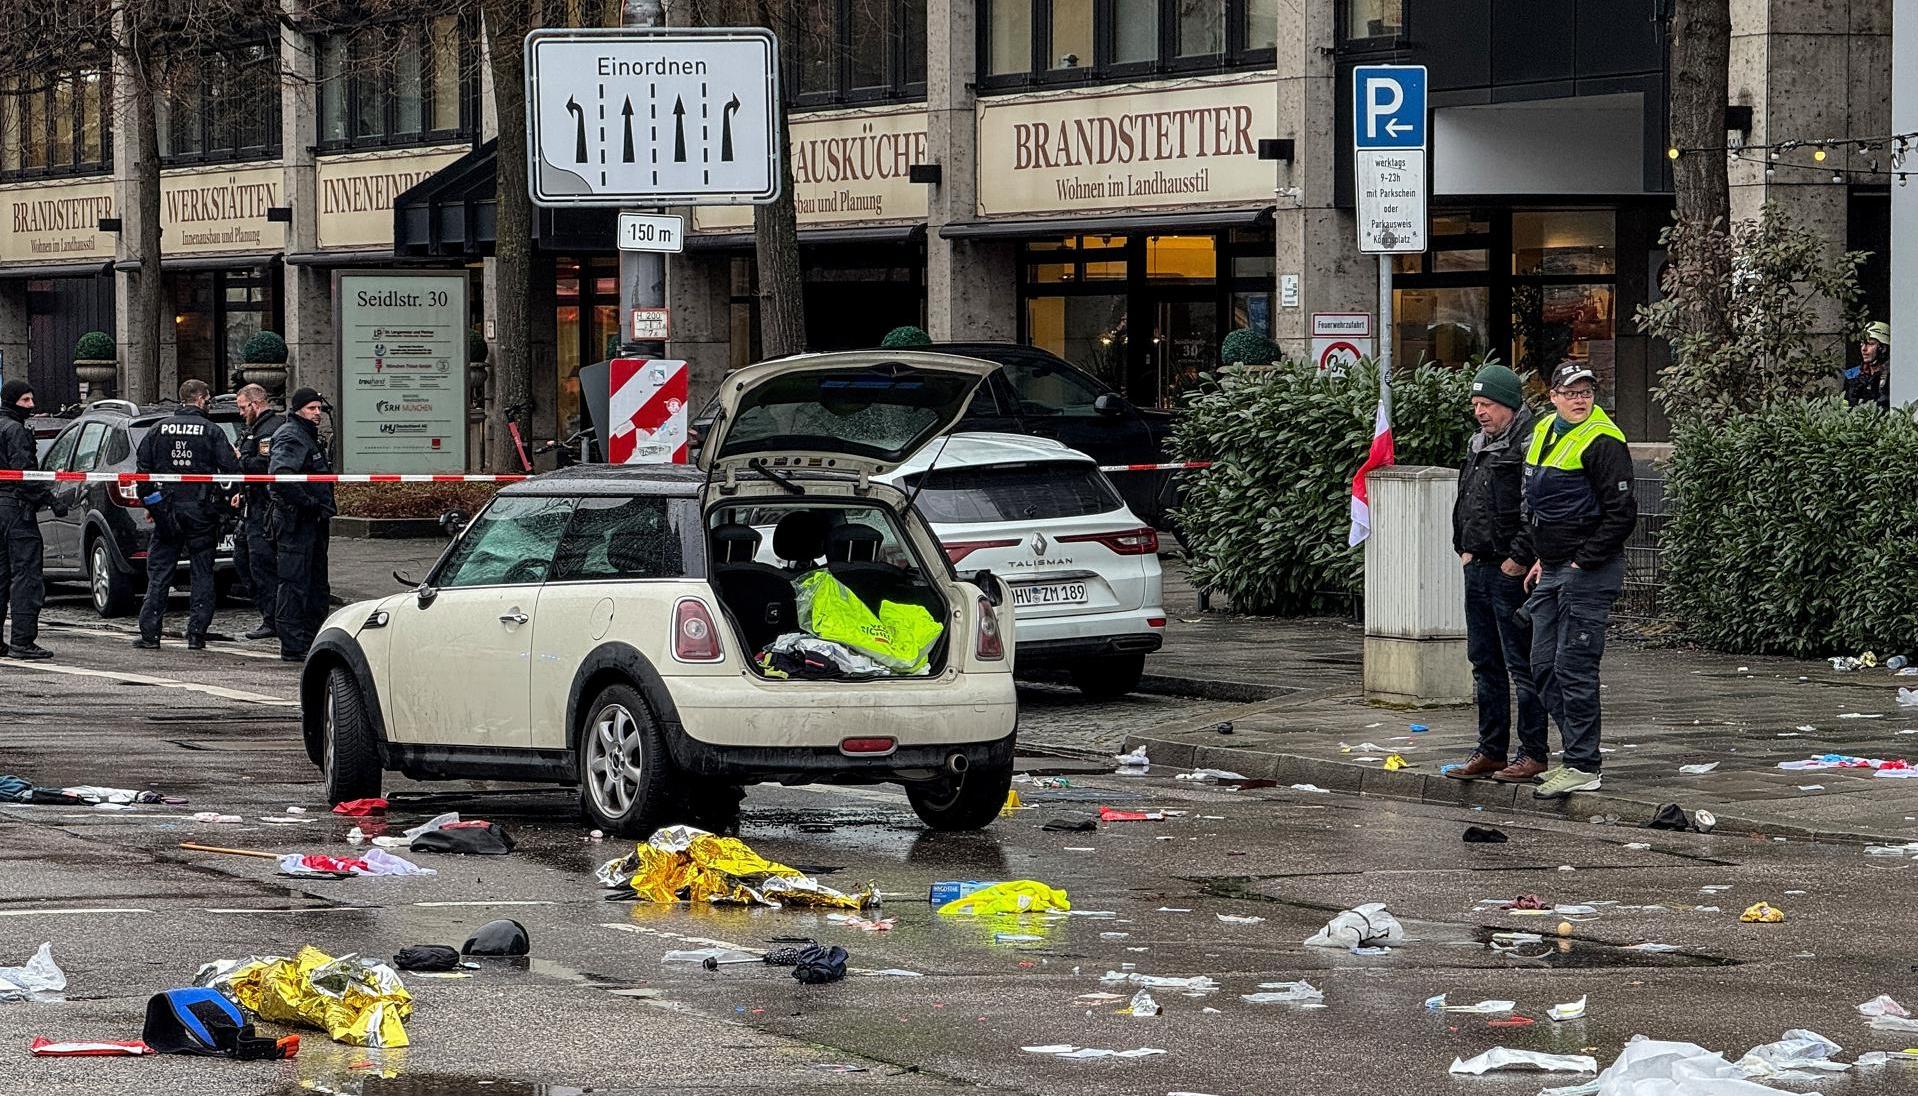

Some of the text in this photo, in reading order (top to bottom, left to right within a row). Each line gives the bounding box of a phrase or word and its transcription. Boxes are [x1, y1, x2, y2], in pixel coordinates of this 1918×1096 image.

[598, 57, 706, 75] Einordnen
[1367, 78, 1404, 138] P
[1014, 105, 1256, 170] BRANDSTETTER
[790, 122, 928, 183] AUSKÜCHE
[1375, 157, 1406, 169] werktags
[1056, 168, 1209, 201] Wohnen im Landhausstil
[1380, 172, 1401, 182] 9-23h
[166, 176, 277, 223] WERKSTÄTTEN
[1366, 188, 1416, 198] mit Parkschein
[818, 191, 837, 212] und
[840, 190, 882, 215] Planung
[1383, 204, 1399, 213] oder
[13, 196, 112, 233] BRANDSTETTER
[1371, 218, 1412, 229] Parkausweis
[182, 226, 261, 246] Innenausbau und Planung
[630, 223, 671, 242] 150 m
[31, 235, 95, 253] Wohnen im Landhausstil
[357, 290, 448, 307] Seidlstr. 30
[1318, 320, 1365, 329] Feuerwehrzufahrt
[384, 404, 400, 412] SRH
[161, 424, 204, 435] POLIZEI
[175, 440, 187, 450] BY
[171, 450, 193, 458] 6240
[1008, 557, 1073, 568] TALISMAN
[1011, 585, 1085, 604] HV ZM 189
